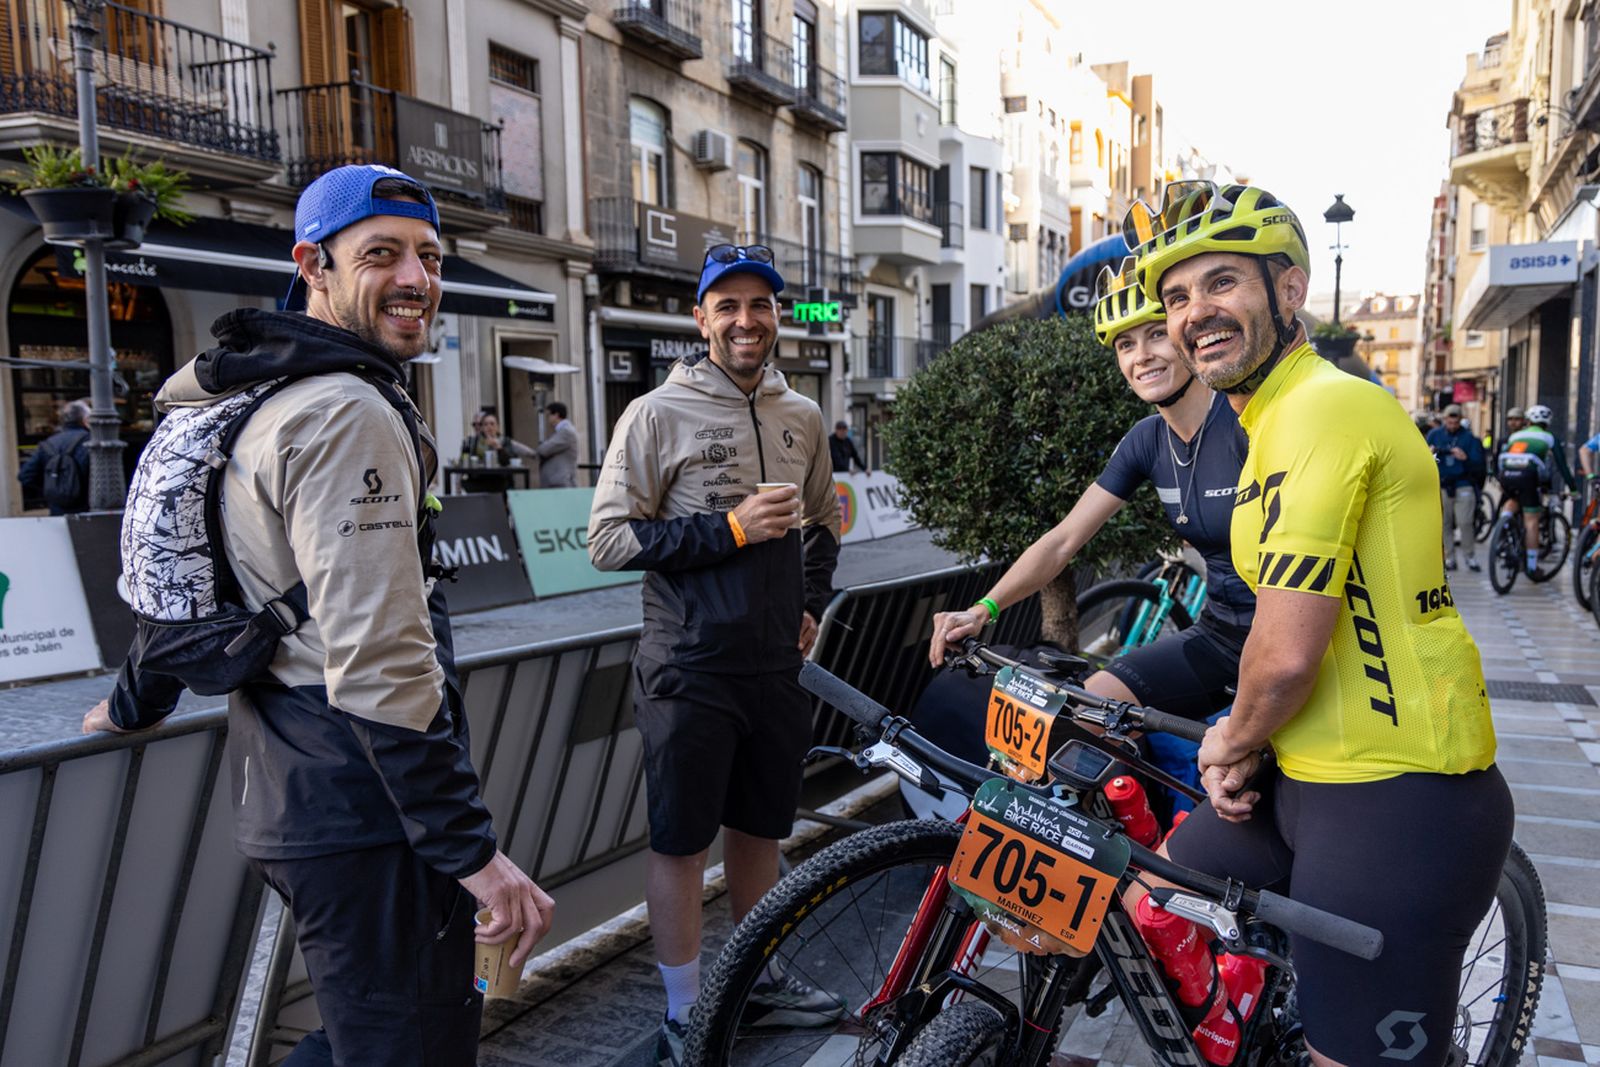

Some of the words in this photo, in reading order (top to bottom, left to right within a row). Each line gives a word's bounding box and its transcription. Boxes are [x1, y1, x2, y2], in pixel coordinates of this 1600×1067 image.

[349, 495, 402, 506] SCOTT
[59, 628, 74, 637] de
[13, 646, 29, 656] de
[32, 642, 63, 653] Jaén
[994, 696, 1046, 762] 705-2
[1003, 810, 1028, 830] BIKE
[1030, 824, 1060, 844] RACE
[1008, 797, 1063, 836] Andalucía
[969, 822, 1097, 932] 705-1
[997, 896, 1044, 925] MARTINEZ
[1060, 929, 1075, 940] ESP
[1511, 960, 1539, 1052] MAXXIS
